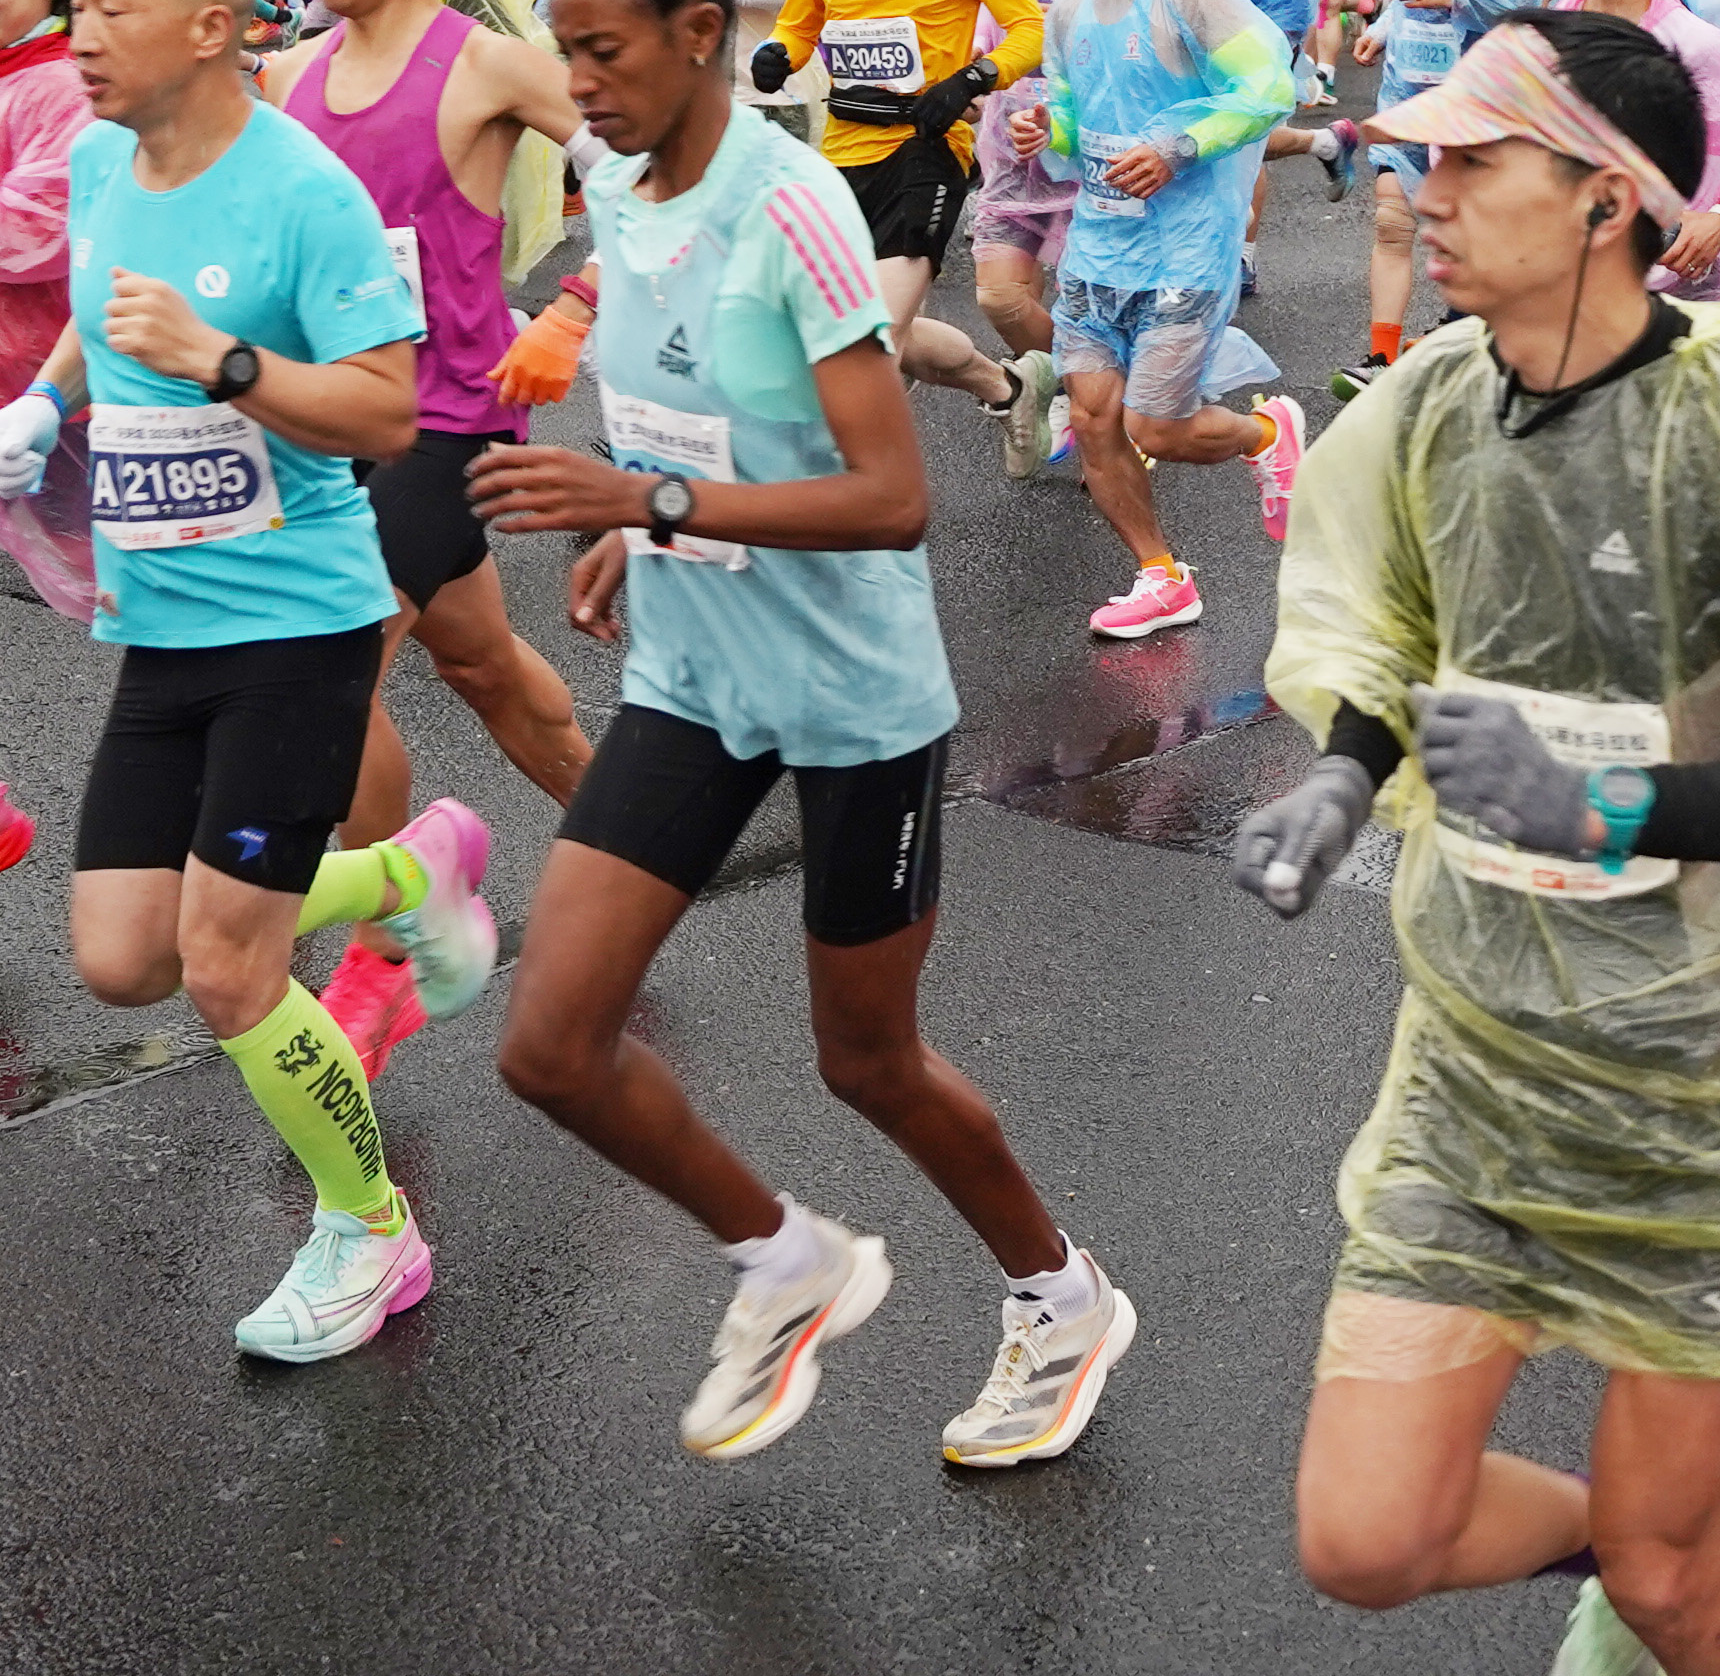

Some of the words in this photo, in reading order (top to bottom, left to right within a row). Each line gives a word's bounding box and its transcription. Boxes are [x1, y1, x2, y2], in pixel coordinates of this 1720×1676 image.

[831, 47, 848, 72] A
[846, 45, 909, 70] 20459
[93, 459, 120, 506] A
[123, 453, 248, 502] 21895
[305, 1059, 383, 1184] HANDRAGON
